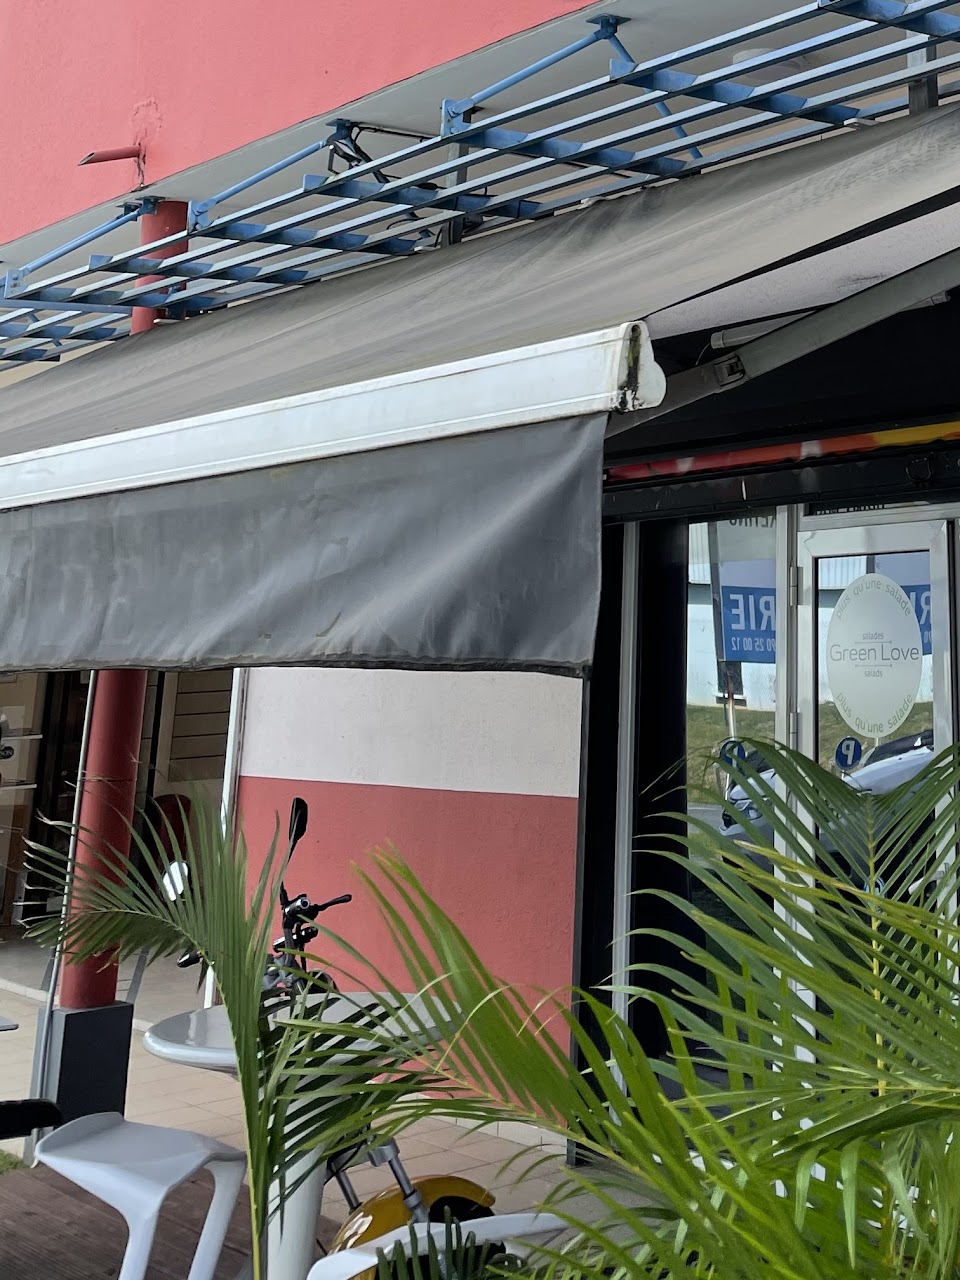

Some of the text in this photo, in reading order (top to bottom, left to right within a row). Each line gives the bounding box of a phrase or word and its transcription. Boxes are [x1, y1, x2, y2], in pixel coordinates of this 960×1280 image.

[836, 595, 850, 620] plus
[885, 583, 911, 617] salade
[862, 631, 885, 641] salades
[830, 643, 920, 662] Green Love
[836, 692, 852, 718] plus
[887, 693, 913, 730] salade
